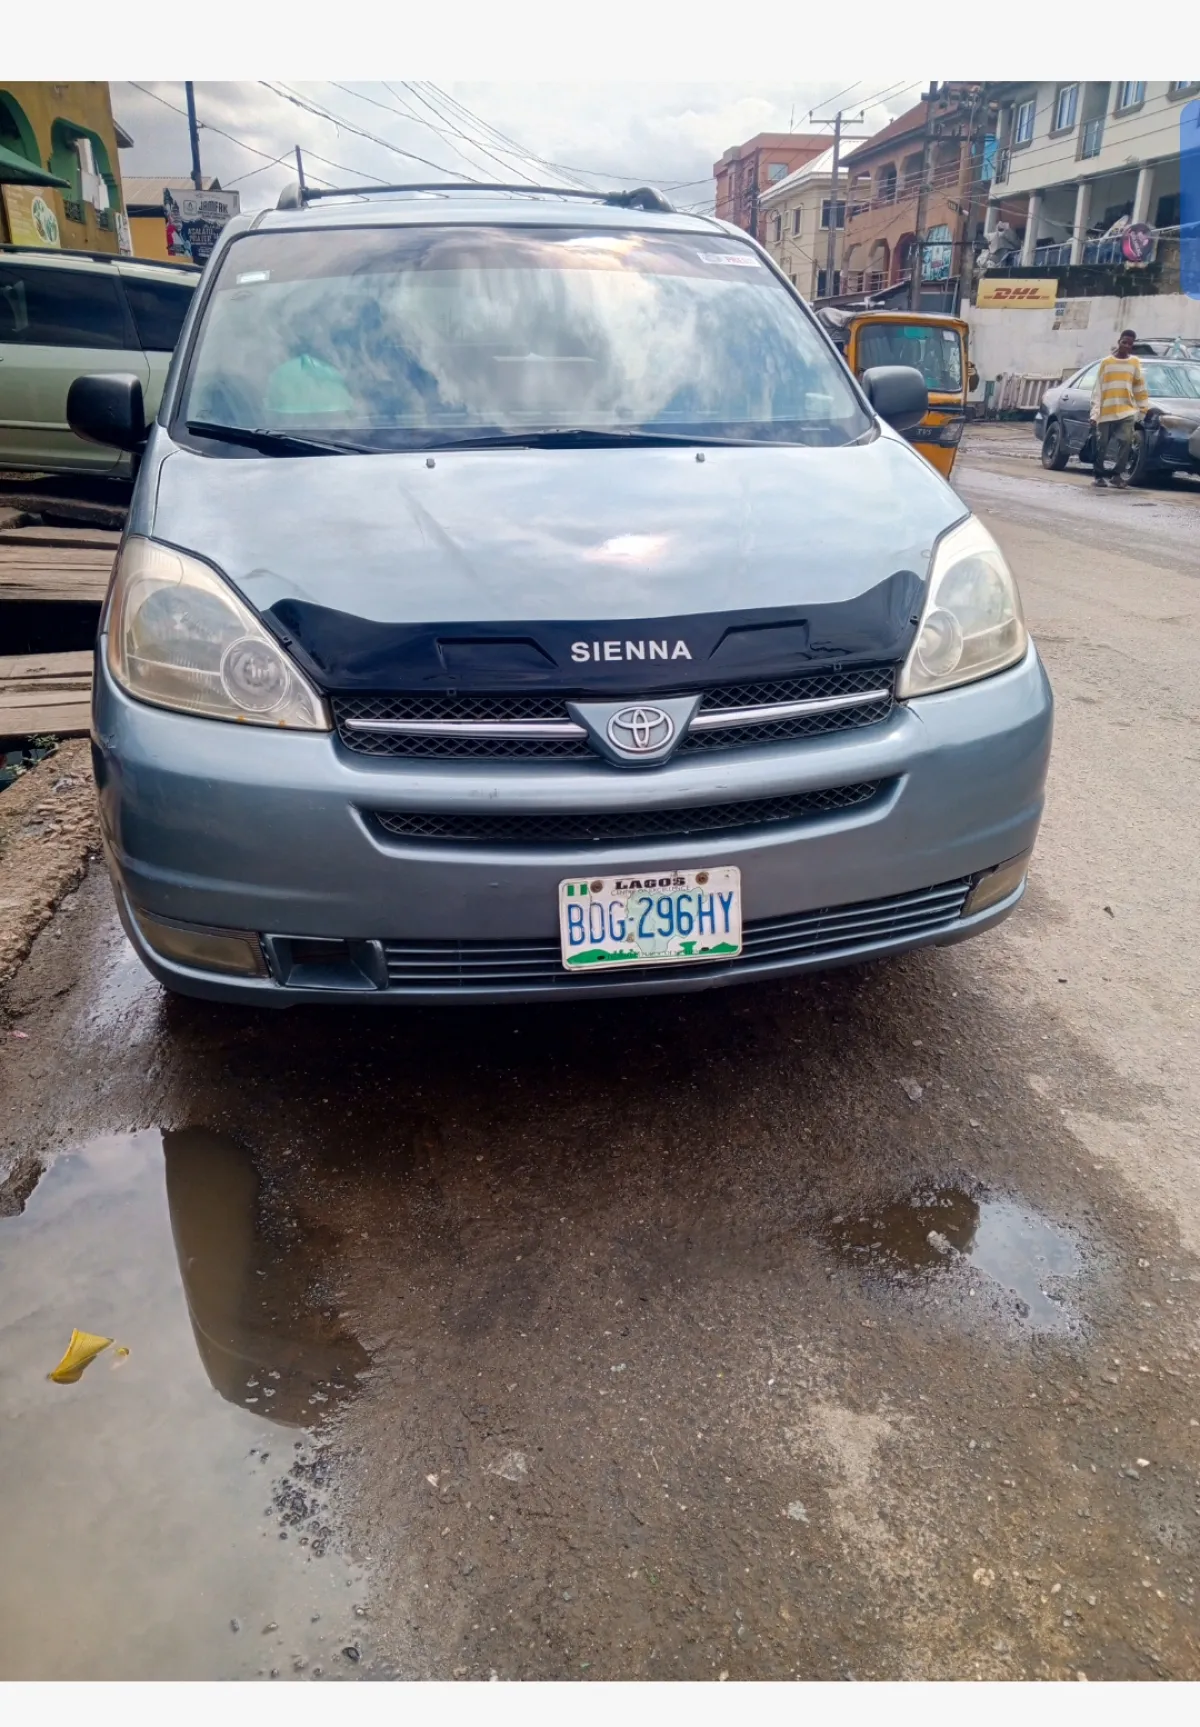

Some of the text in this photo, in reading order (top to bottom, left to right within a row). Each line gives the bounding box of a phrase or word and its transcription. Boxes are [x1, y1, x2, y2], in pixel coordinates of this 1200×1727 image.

[992, 288, 1041, 299] DHL
[916, 428, 933, 436] TVS
[571, 640, 693, 662] SIENNA
[615, 877, 686, 890] LAGOS
